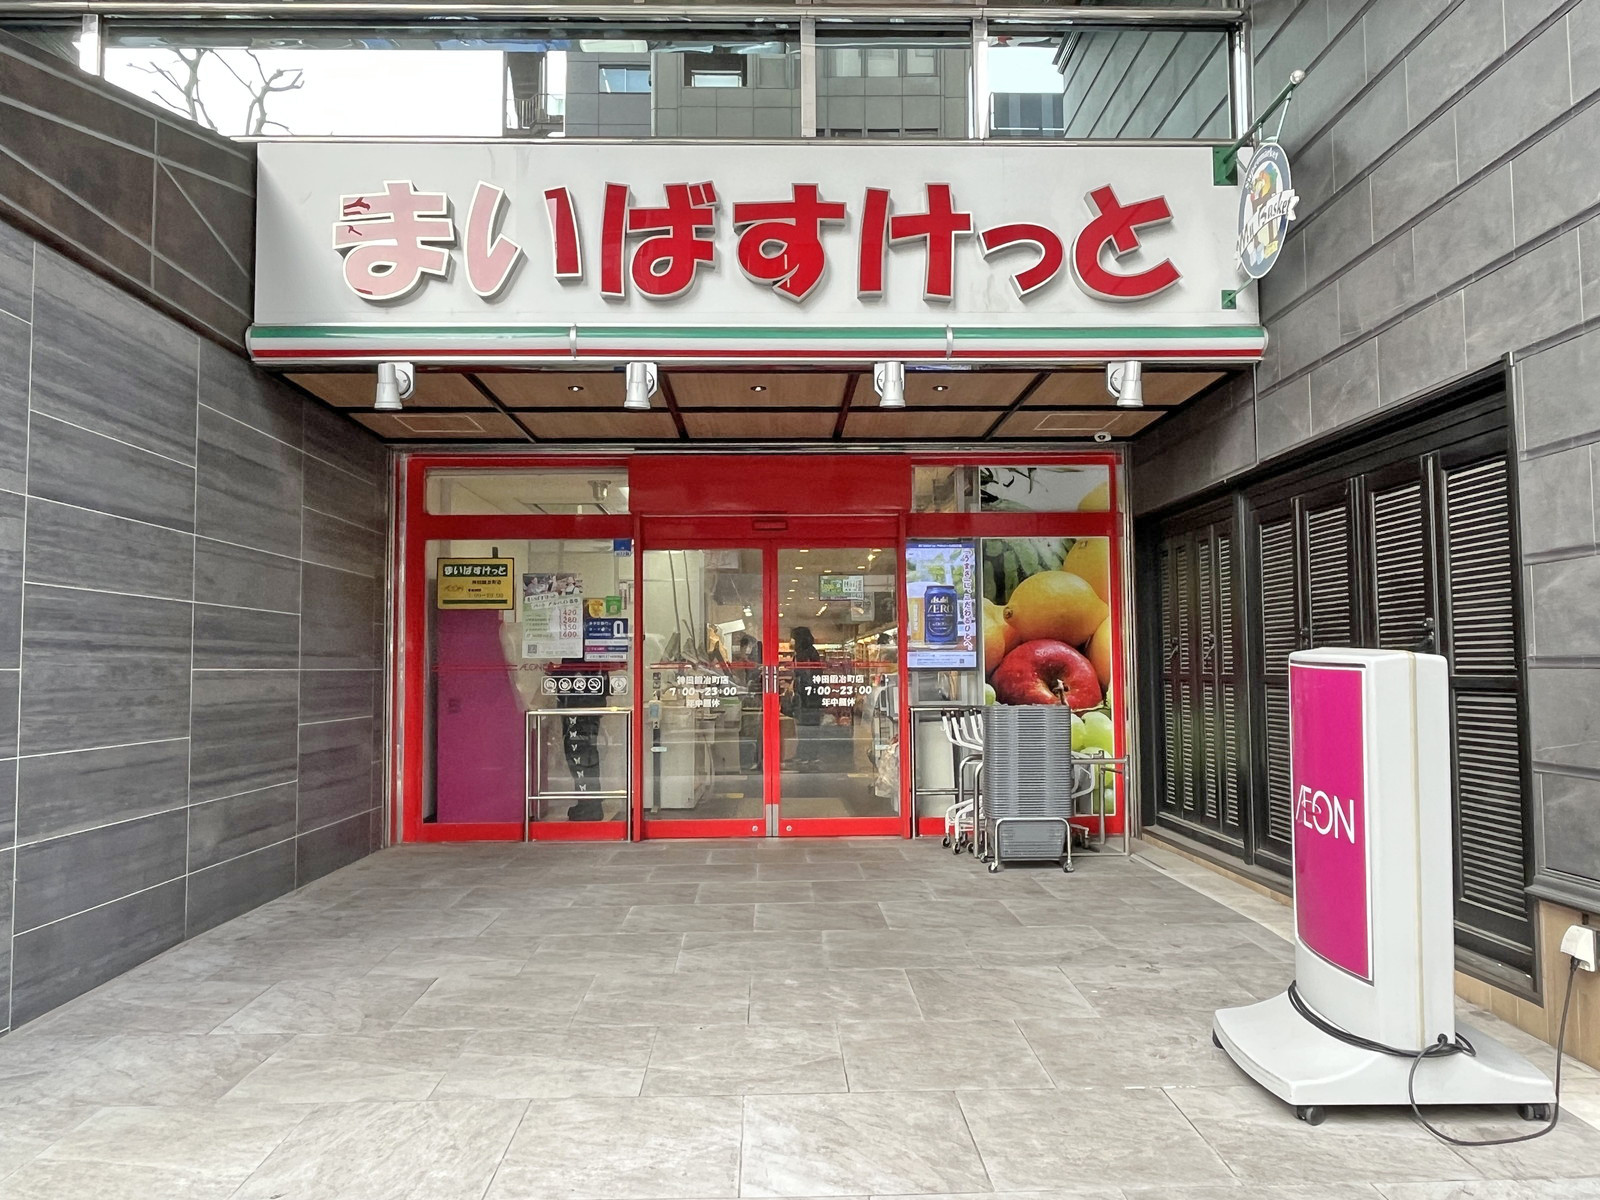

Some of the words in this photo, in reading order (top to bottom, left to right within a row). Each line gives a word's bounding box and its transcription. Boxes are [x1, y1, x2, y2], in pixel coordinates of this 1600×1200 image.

[333, 180, 1183, 304] まいばすけっと
